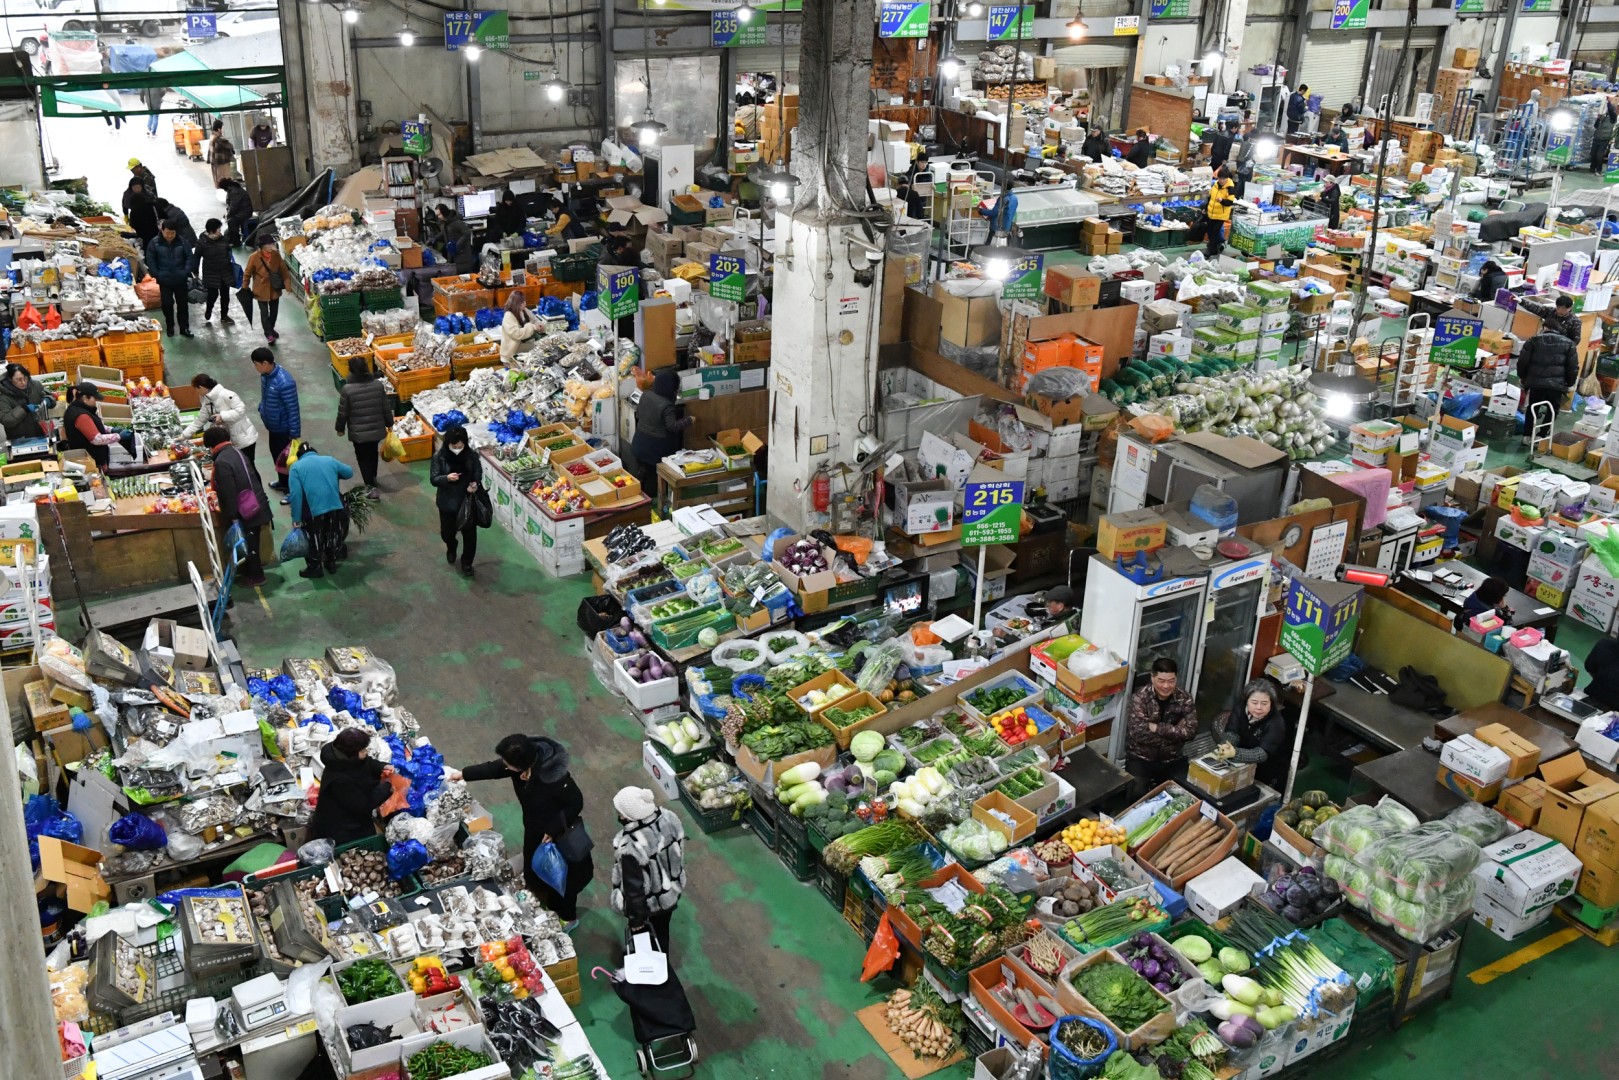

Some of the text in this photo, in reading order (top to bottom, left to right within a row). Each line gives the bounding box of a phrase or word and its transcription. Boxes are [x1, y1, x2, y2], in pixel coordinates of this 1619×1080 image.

[882, 11, 904, 23] 277
[1335, 6, 1350, 16] 200
[192, 16, 199, 28] P
[714, 20, 737, 33] 235
[991, 14, 1008, 27] 147
[447, 21, 471, 36] 177
[404, 125, 419, 135] 244
[1553, 136, 1566, 146] 117
[715, 260, 740, 274] 202
[599, 272, 609, 289] 190
[615, 274, 635, 289] 190
[1443, 323, 1473, 337] 158
[973, 489, 1013, 506] 215
[1245, 569, 1259, 578] FINE
[1183, 579, 1196, 587] FINE
[1295, 591, 1322, 627] 111
[1334, 598, 1359, 627] 111
